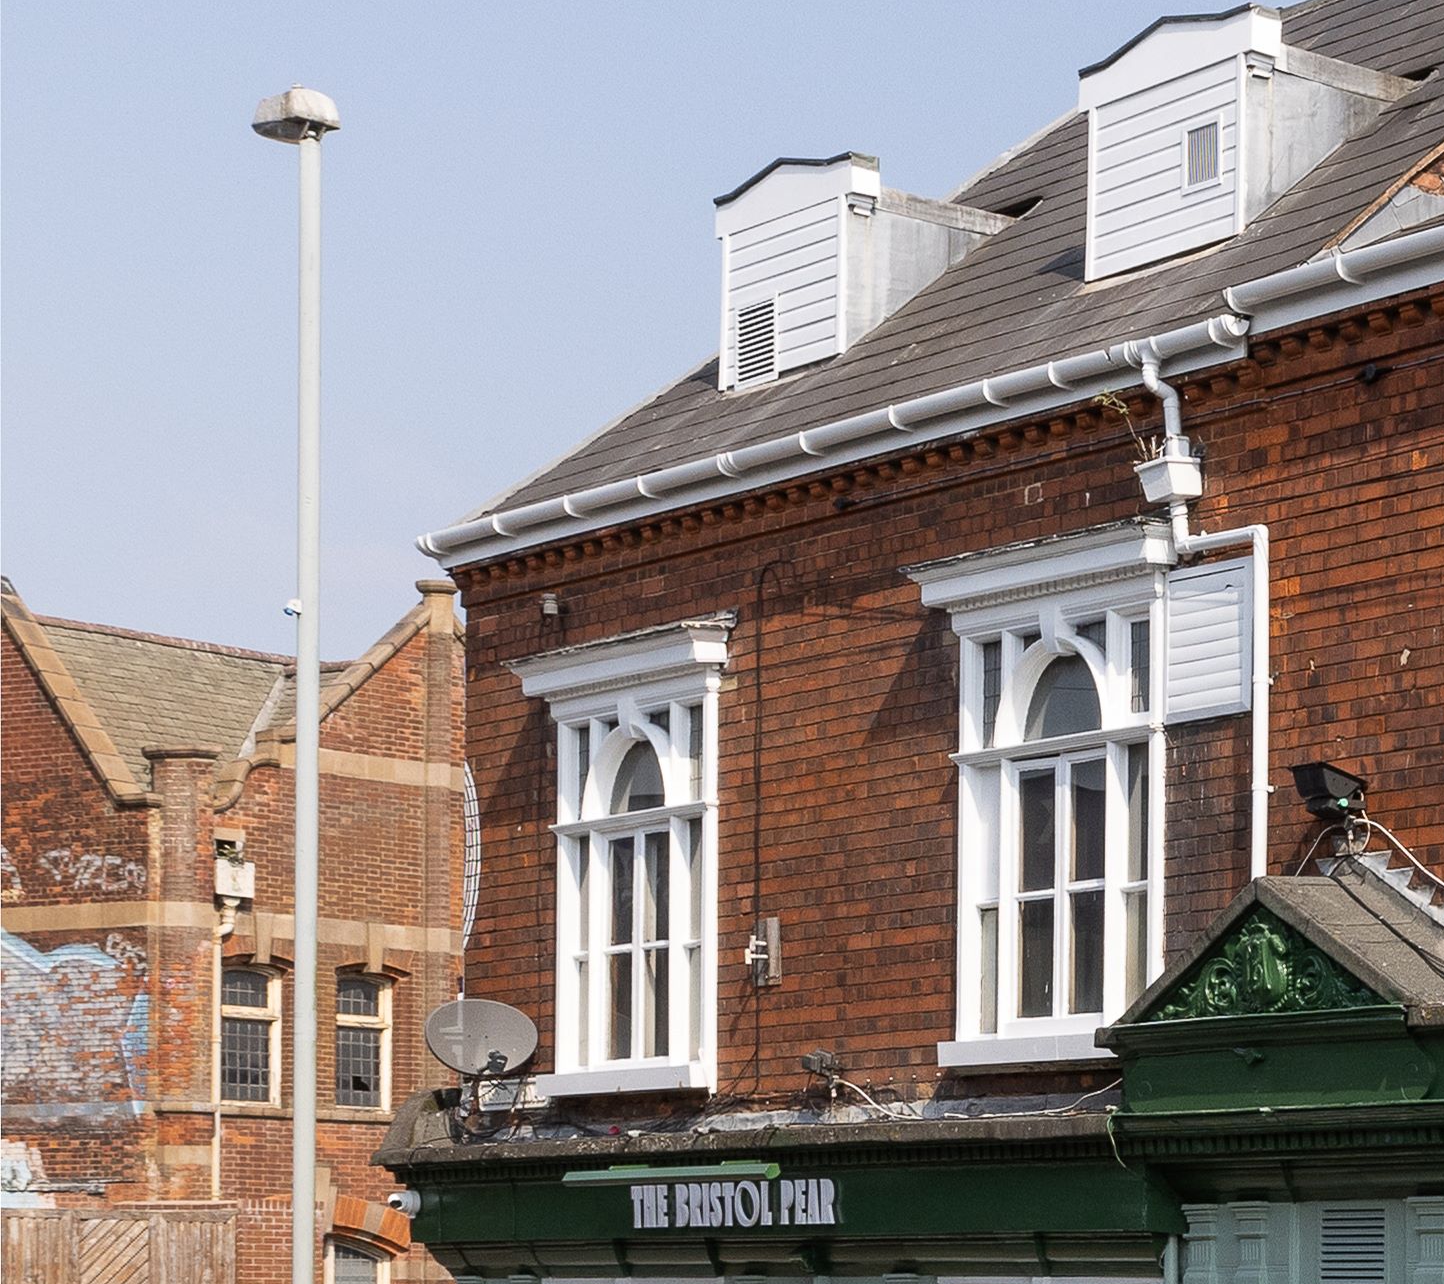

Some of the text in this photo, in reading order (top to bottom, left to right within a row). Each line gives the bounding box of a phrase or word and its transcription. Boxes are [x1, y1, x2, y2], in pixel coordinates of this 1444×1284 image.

[630, 1178, 836, 1229] THE BRISTOL PEAR
